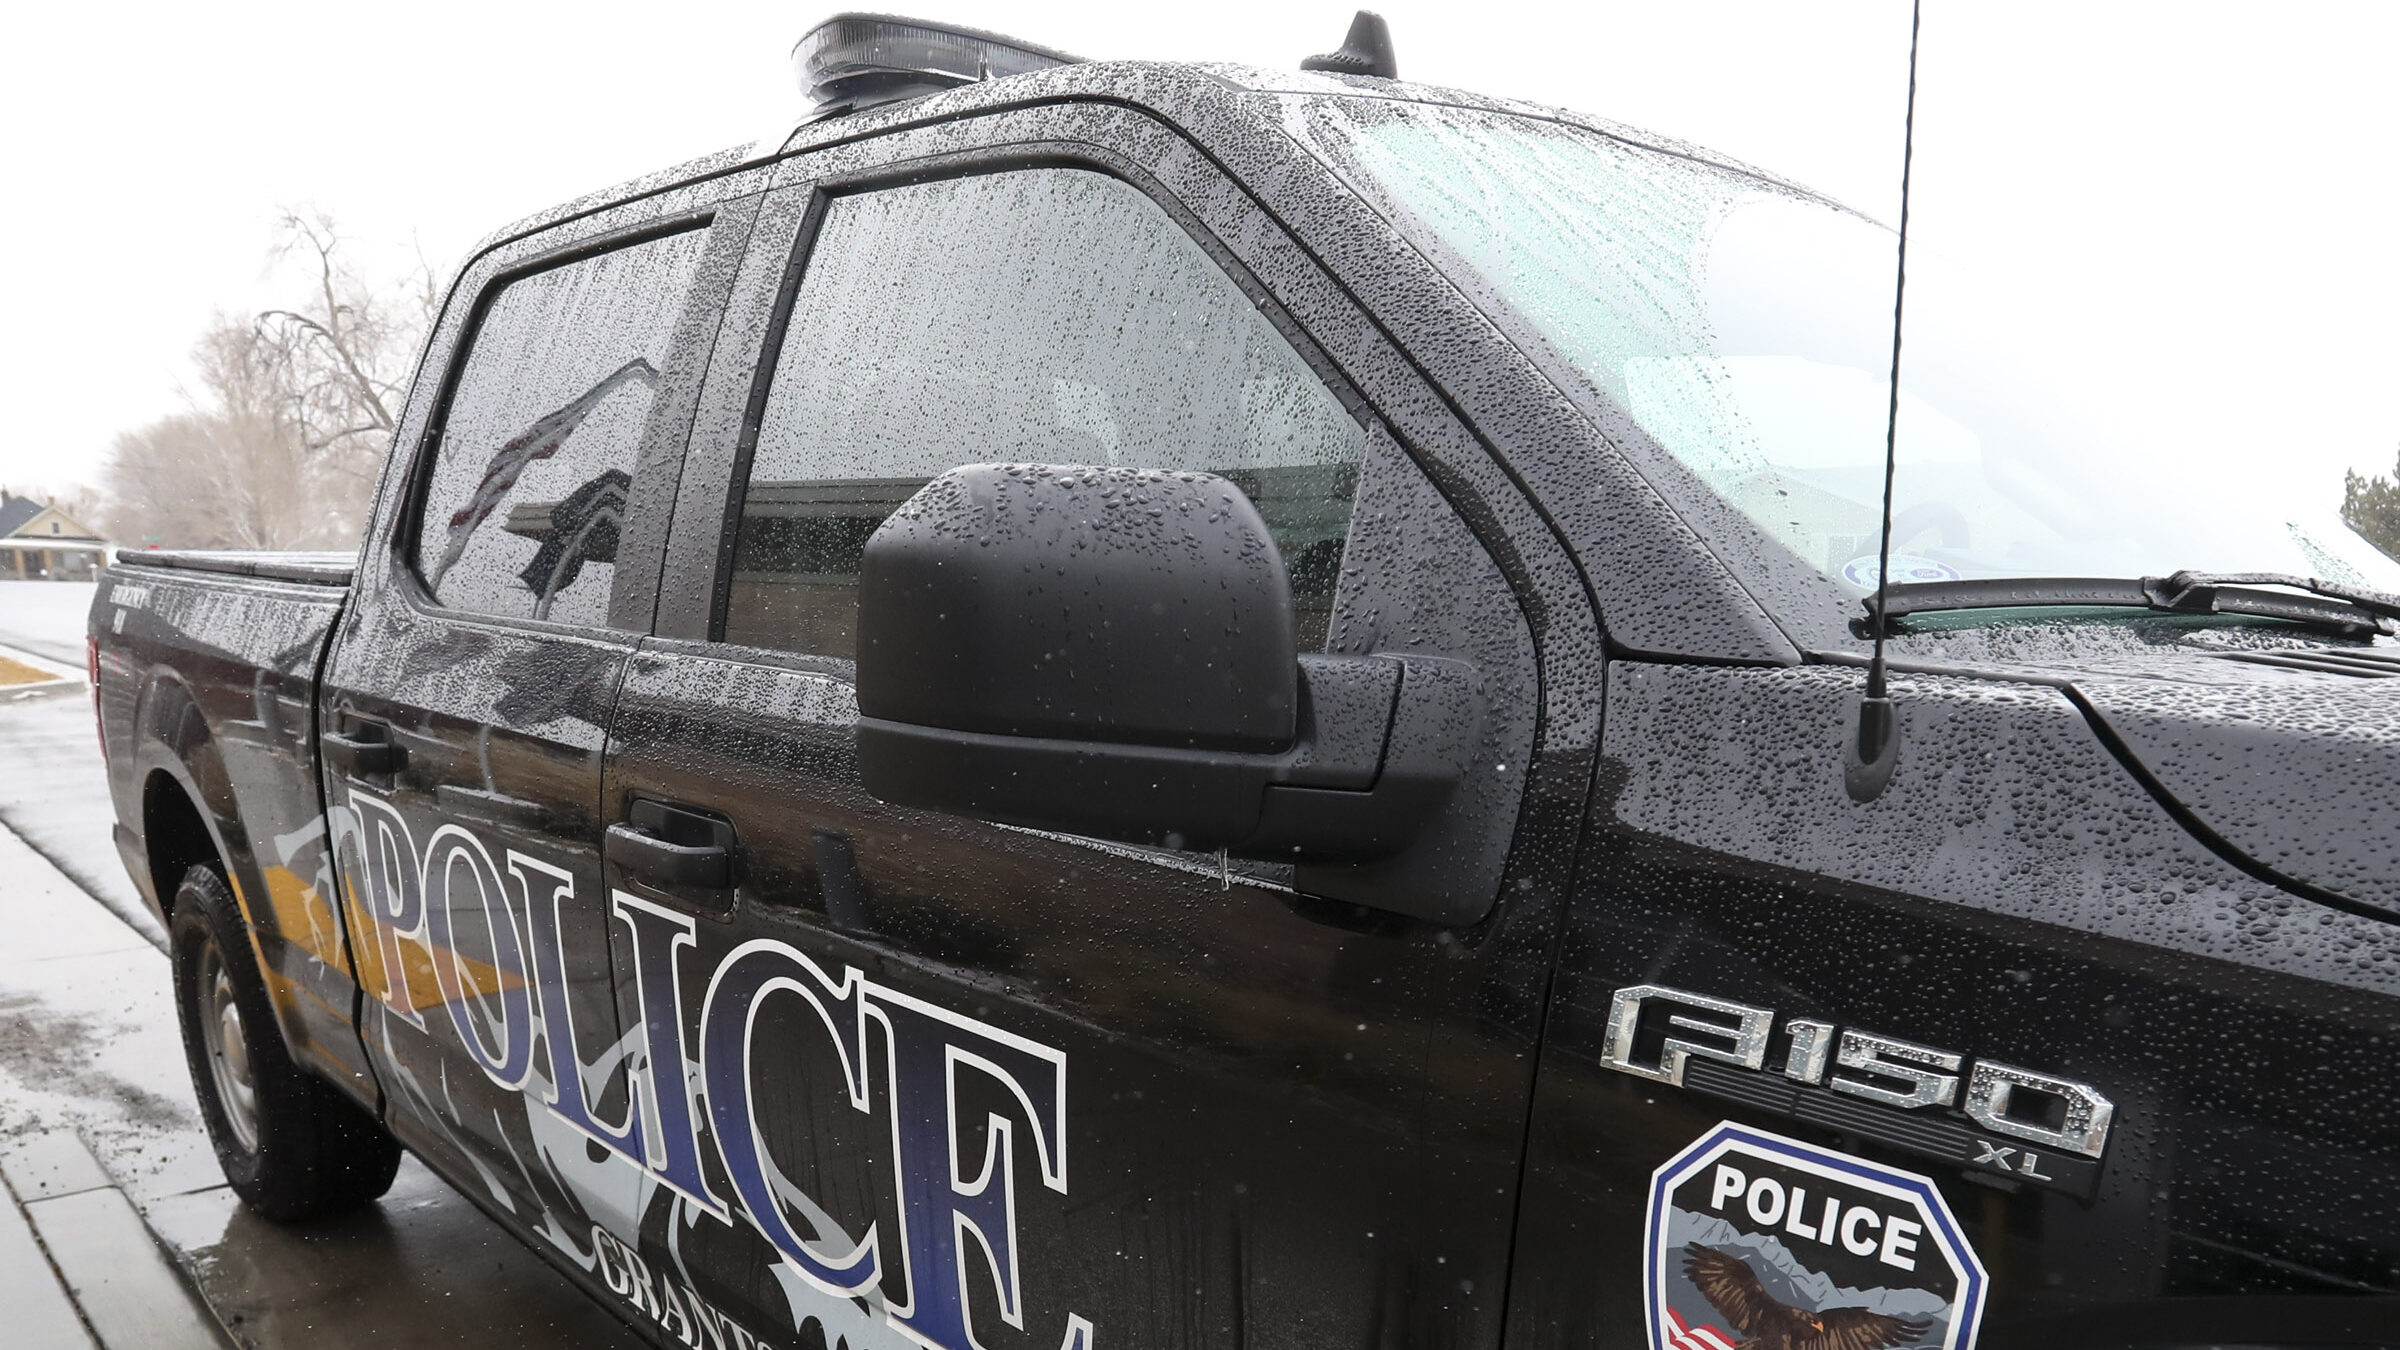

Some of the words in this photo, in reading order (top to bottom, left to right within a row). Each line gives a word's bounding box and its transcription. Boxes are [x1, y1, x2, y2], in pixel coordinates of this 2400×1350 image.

[349, 788, 1094, 1350] POLICE
[1711, 1164, 1922, 1271] POLICE
[1973, 1140, 2052, 1181] XL
[591, 1225, 772, 1350] GRANT
